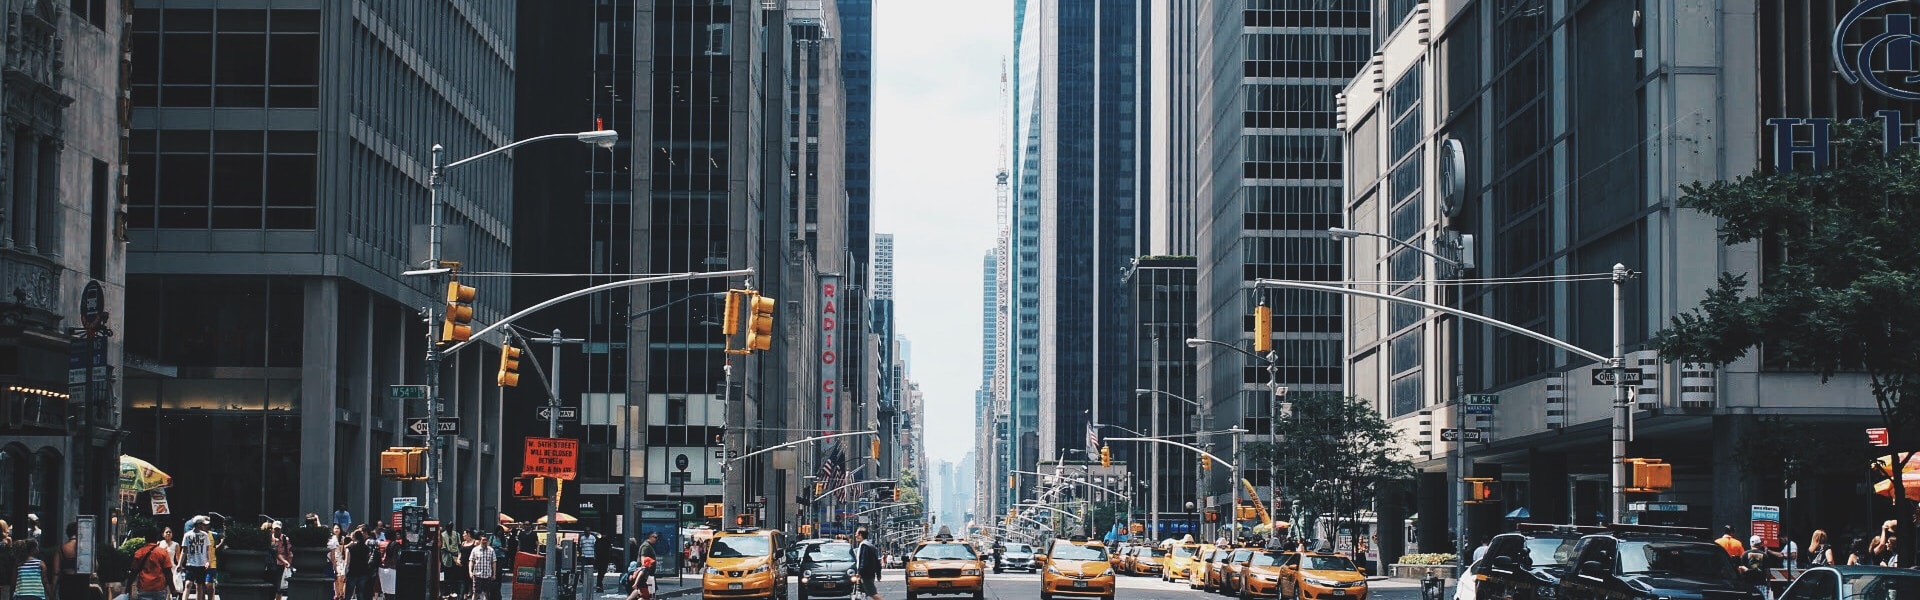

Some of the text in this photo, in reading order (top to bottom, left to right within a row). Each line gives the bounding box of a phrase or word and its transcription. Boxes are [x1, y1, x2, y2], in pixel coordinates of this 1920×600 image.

[822, 283, 836, 444] RADIO CITY
[392, 387, 399, 397] W
[400, 387, 409, 397] 54
[1472, 395, 1478, 403] W
[1481, 395, 1491, 404] 54
